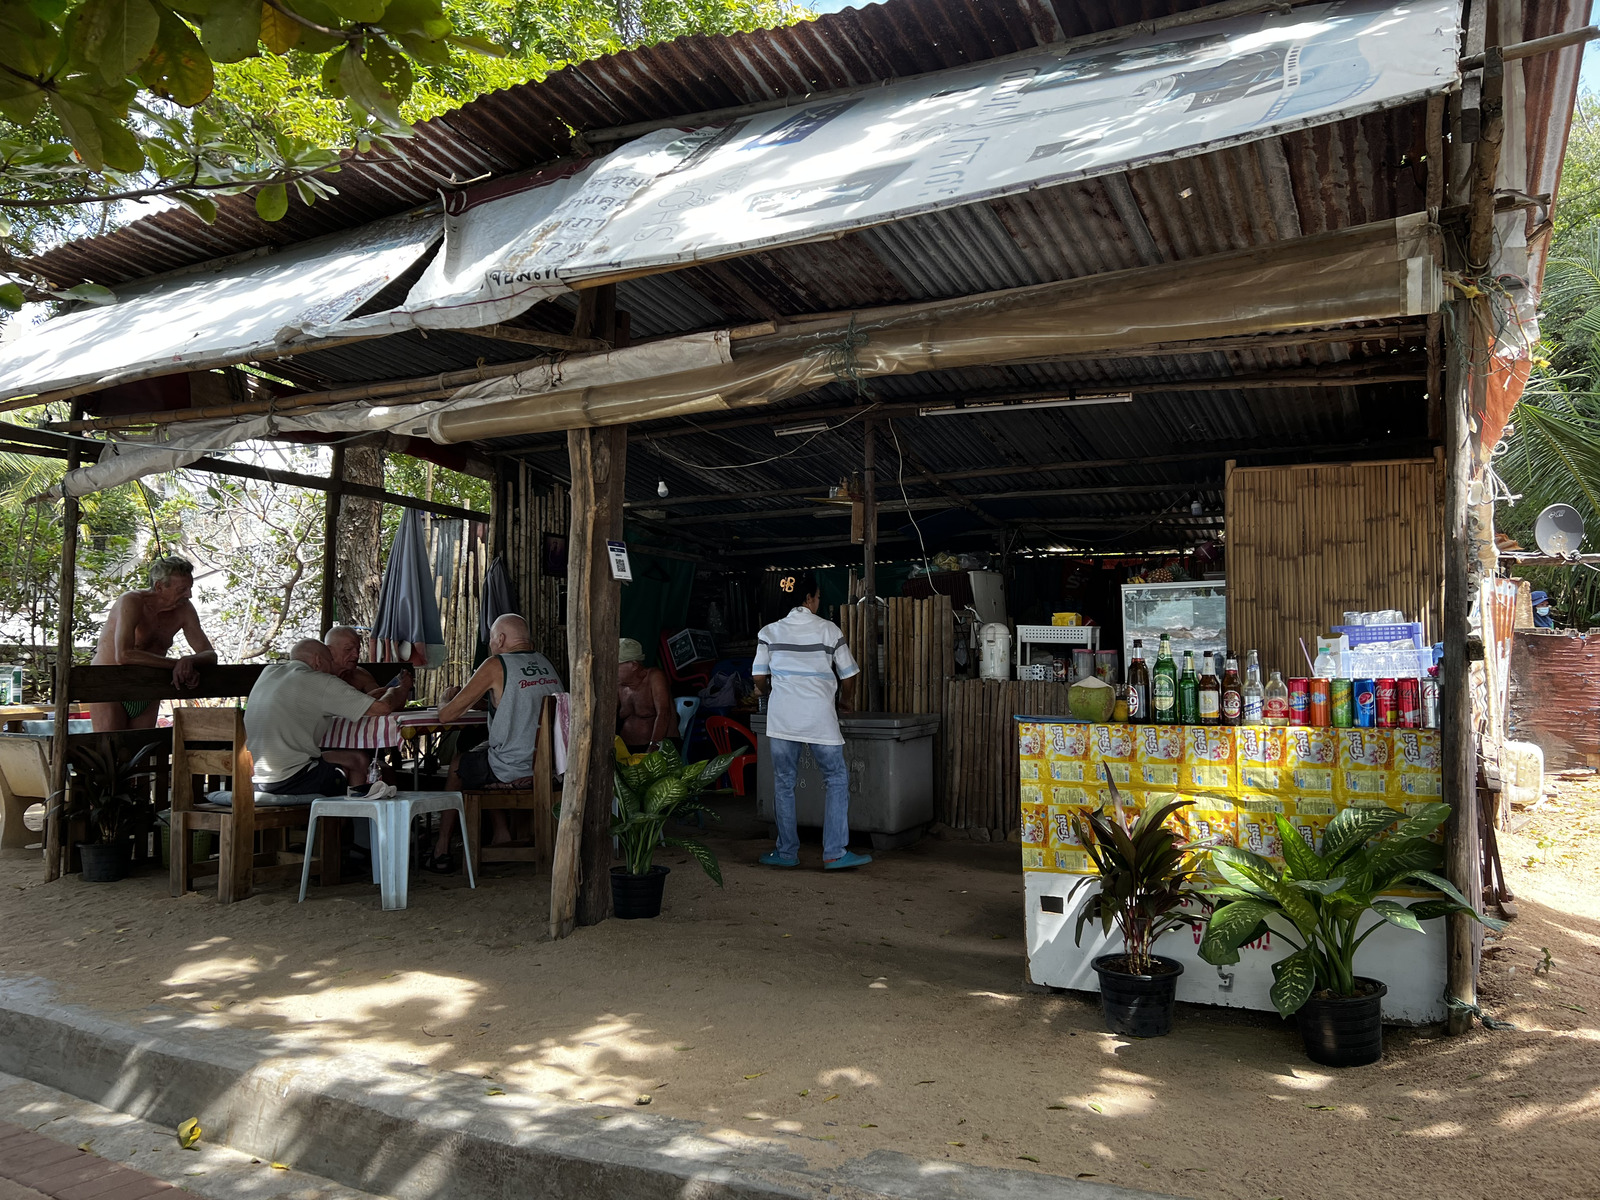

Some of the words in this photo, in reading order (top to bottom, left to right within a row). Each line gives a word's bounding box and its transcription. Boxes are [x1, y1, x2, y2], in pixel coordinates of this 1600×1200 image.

[1153, 688, 1173, 697] Chang
[1126, 696, 1137, 705] EO
[1223, 700, 1240, 709] LEO
